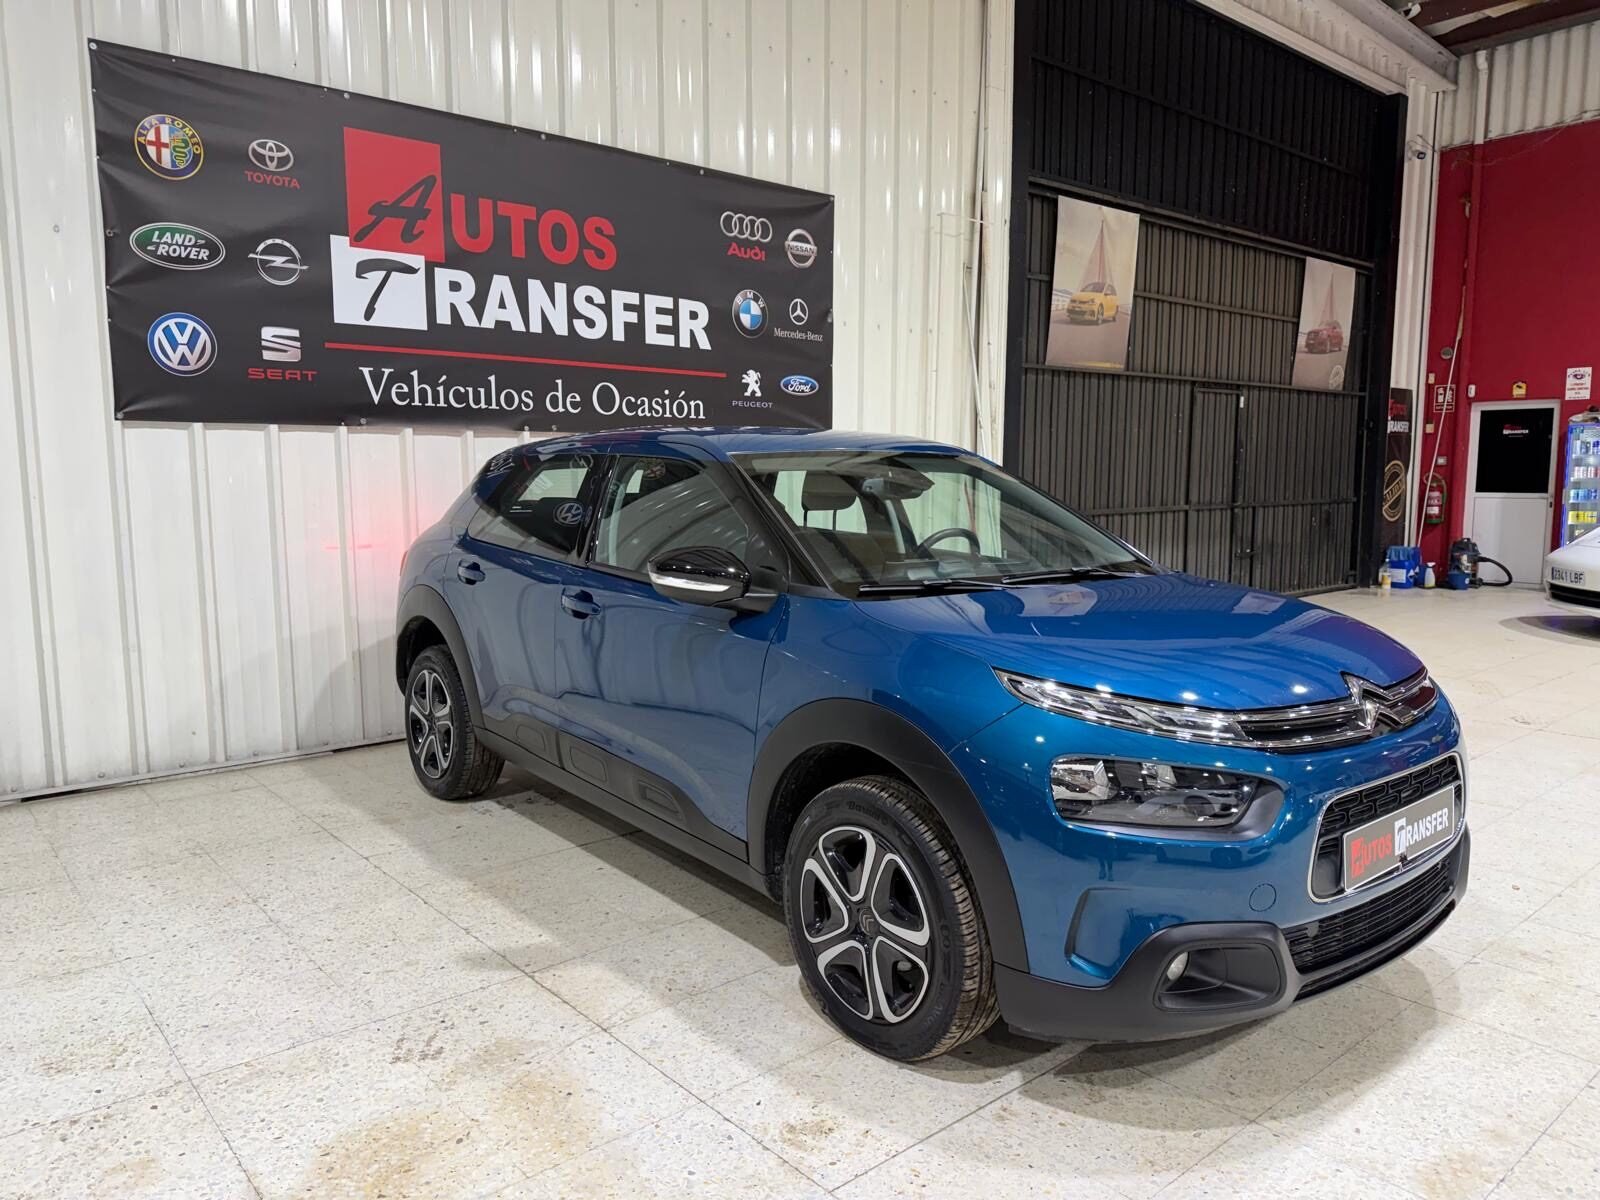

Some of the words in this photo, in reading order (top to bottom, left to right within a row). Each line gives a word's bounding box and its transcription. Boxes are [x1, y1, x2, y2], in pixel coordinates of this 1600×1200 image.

[138, 118, 159, 144] ALFA
[165, 117, 201, 154] ROMEO
[244, 170, 301, 189] TOYOTA
[353, 174, 618, 271] AUTOS
[151, 230, 193, 247] LAND
[156, 244, 210, 261] ROVER
[727, 242, 766, 261] Audi
[788, 244, 815, 254] NISSAN
[355, 257, 712, 351] TRANSFER
[736, 291, 765, 308] BMW
[773, 327, 824, 342] Mercedes-Benz
[248, 367, 318, 382] SEAT
[358, 366, 534, 412] Vehículos
[545, 379, 582, 414] de
[592, 381, 706, 420] Ocasión
[788, 378, 812, 393] Ford
[732, 400, 773, 409] PEUGEOT
[1395, 807, 1449, 854] TRANSFER
